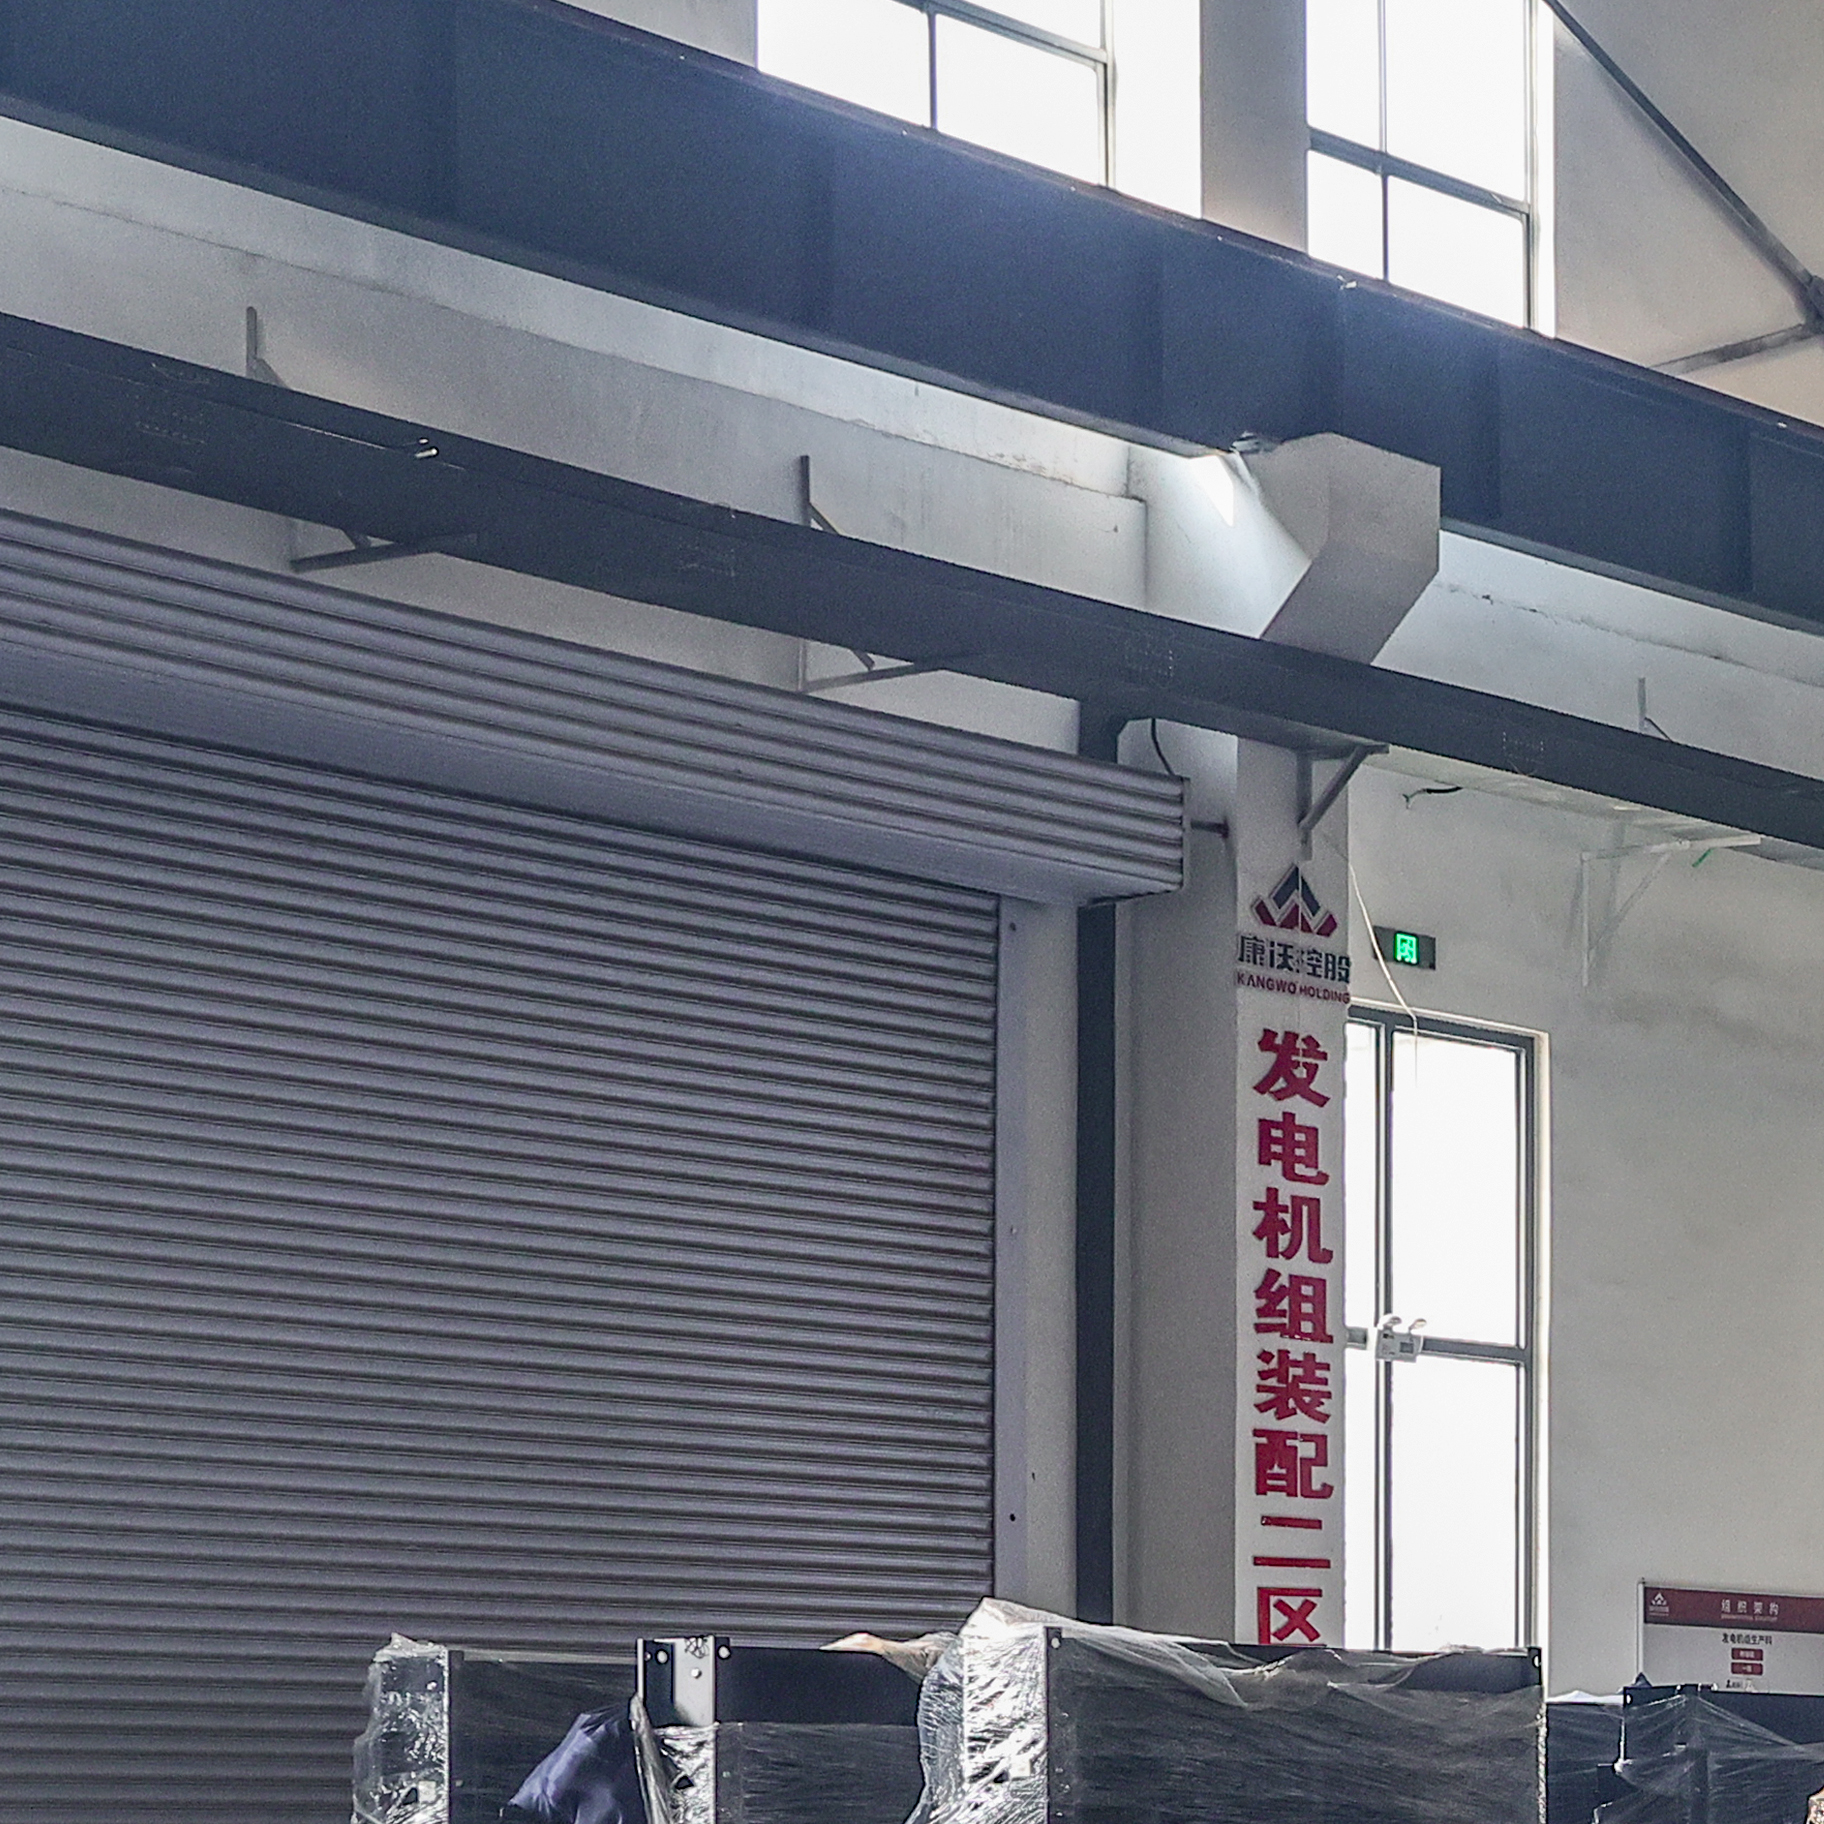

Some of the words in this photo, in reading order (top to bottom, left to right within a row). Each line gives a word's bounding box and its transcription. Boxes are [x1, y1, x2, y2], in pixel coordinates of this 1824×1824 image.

[1238, 934, 1351, 984] 康沃控股
[1236, 971, 1297, 995] KANGWO
[1299, 984, 1350, 1004] HOLDING
[1252, 1028, 1334, 1647] 发电机组装配二区
